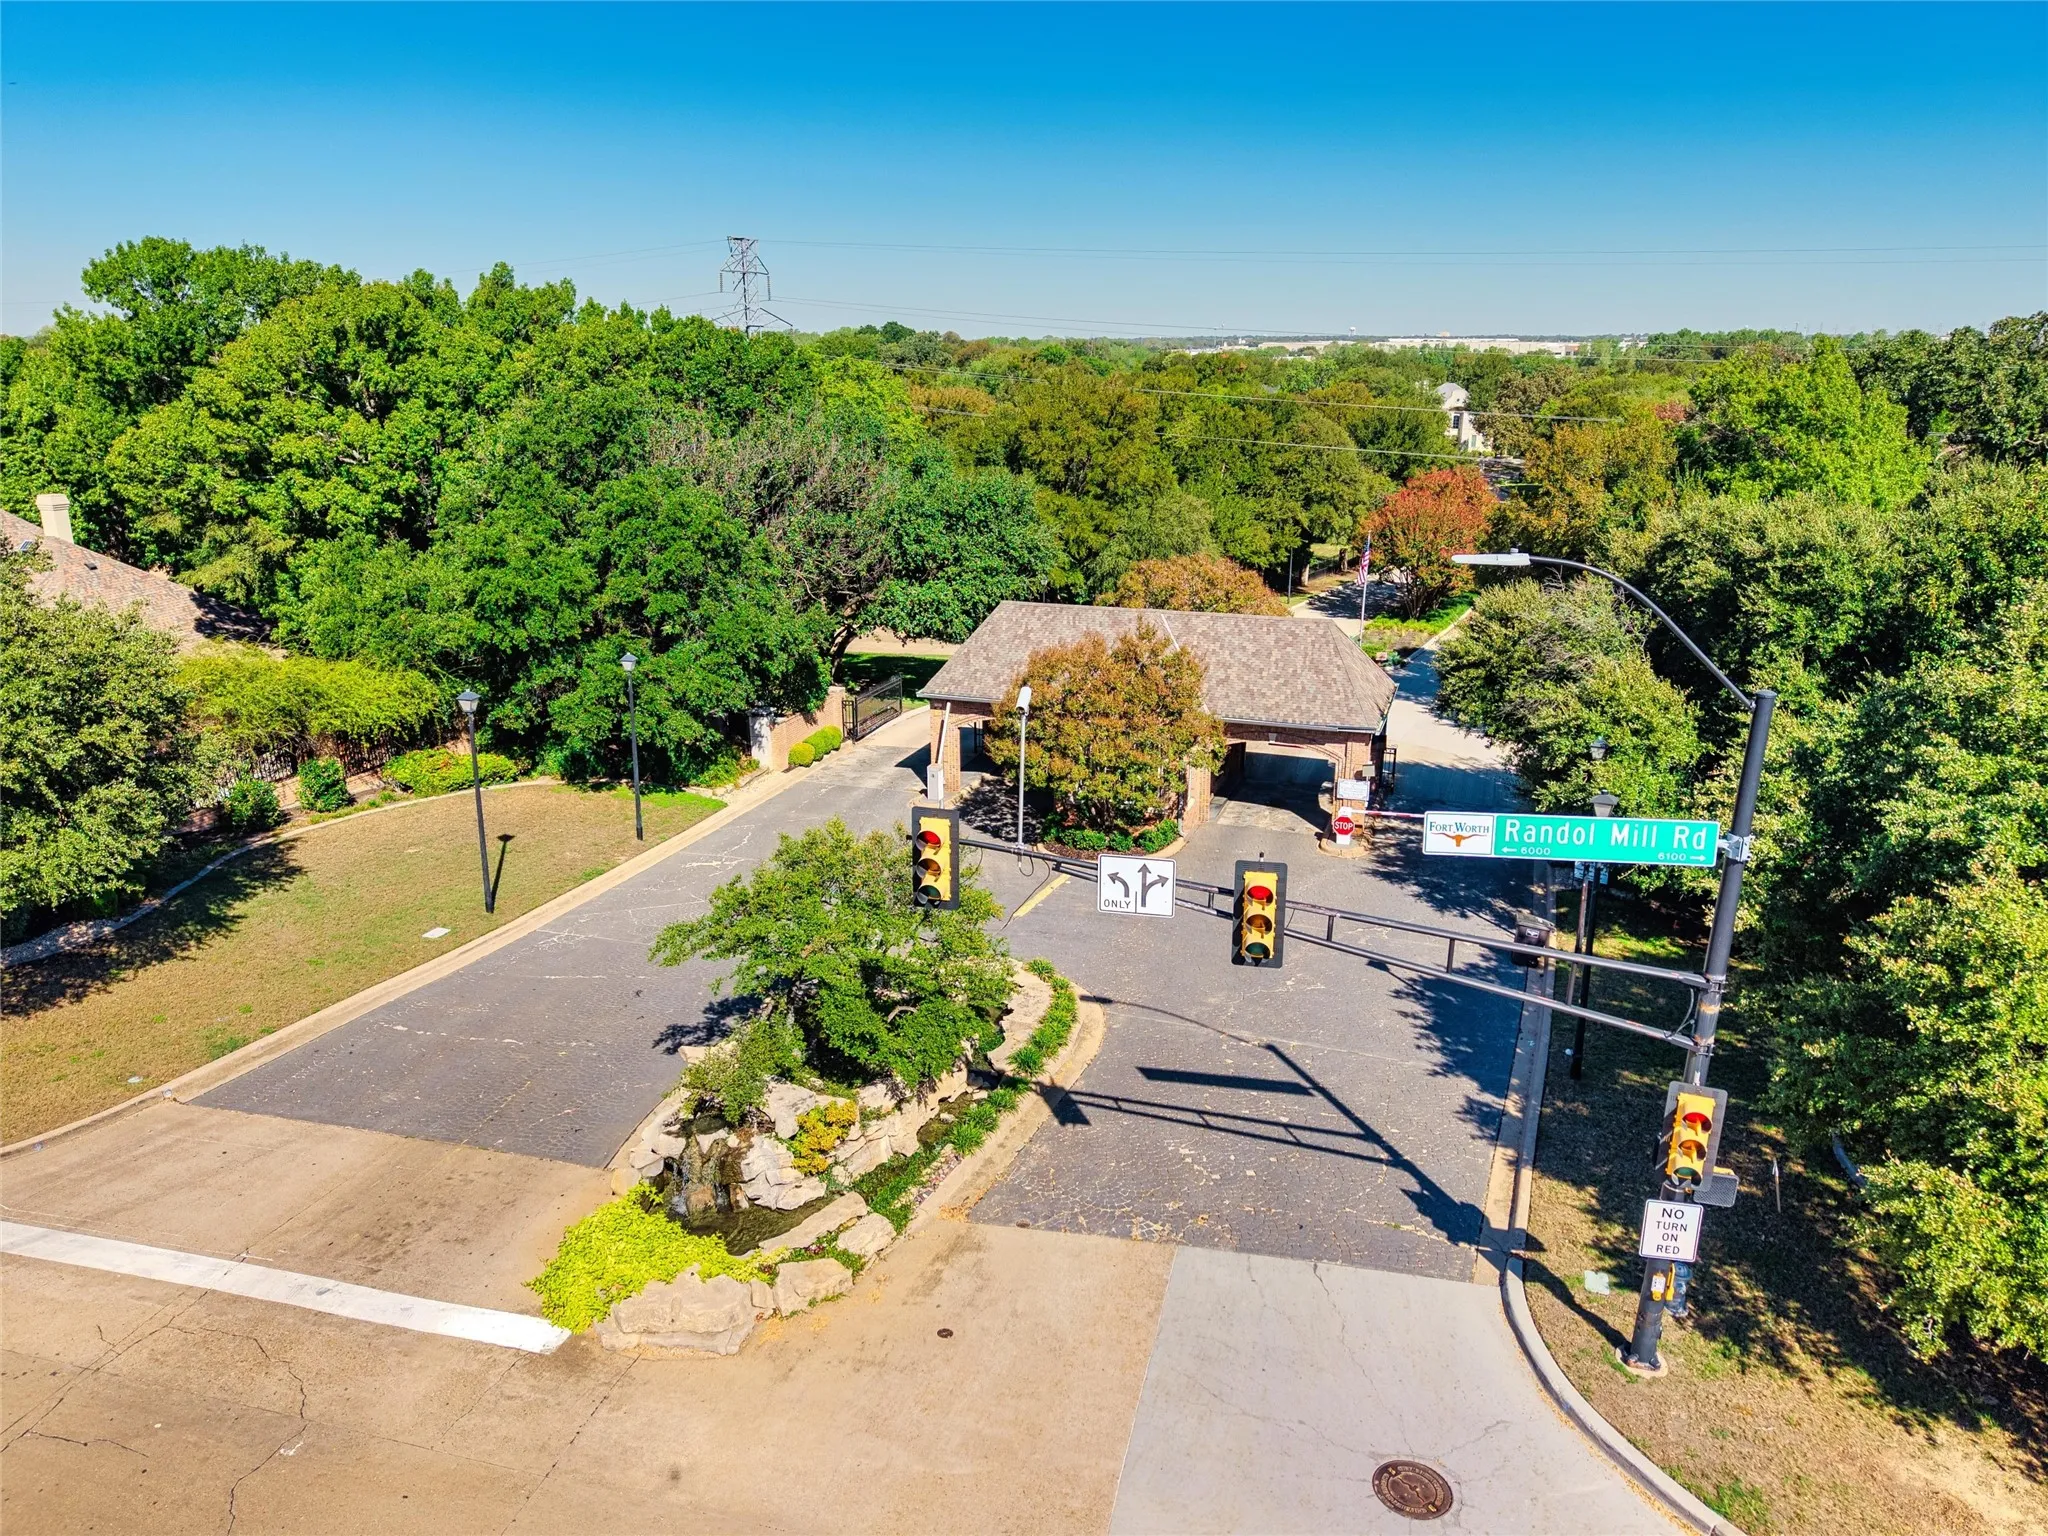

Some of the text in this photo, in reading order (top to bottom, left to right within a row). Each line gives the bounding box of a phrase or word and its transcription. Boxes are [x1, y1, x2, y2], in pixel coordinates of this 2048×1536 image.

[1335, 822, 1353, 830] STOP
[1454, 822, 1489, 833] WORTH
[1505, 819, 1707, 850] Randol Mill Rd
[1520, 847, 1551, 855] 6000
[1657, 852, 1687, 861] 6100
[1103, 899, 1131, 908] ONLY
[1662, 1208, 1684, 1219] NO
[1656, 1221, 1688, 1232] TURN
[1662, 1232, 1678, 1242] ON
[1656, 1244, 1680, 1254] RED
